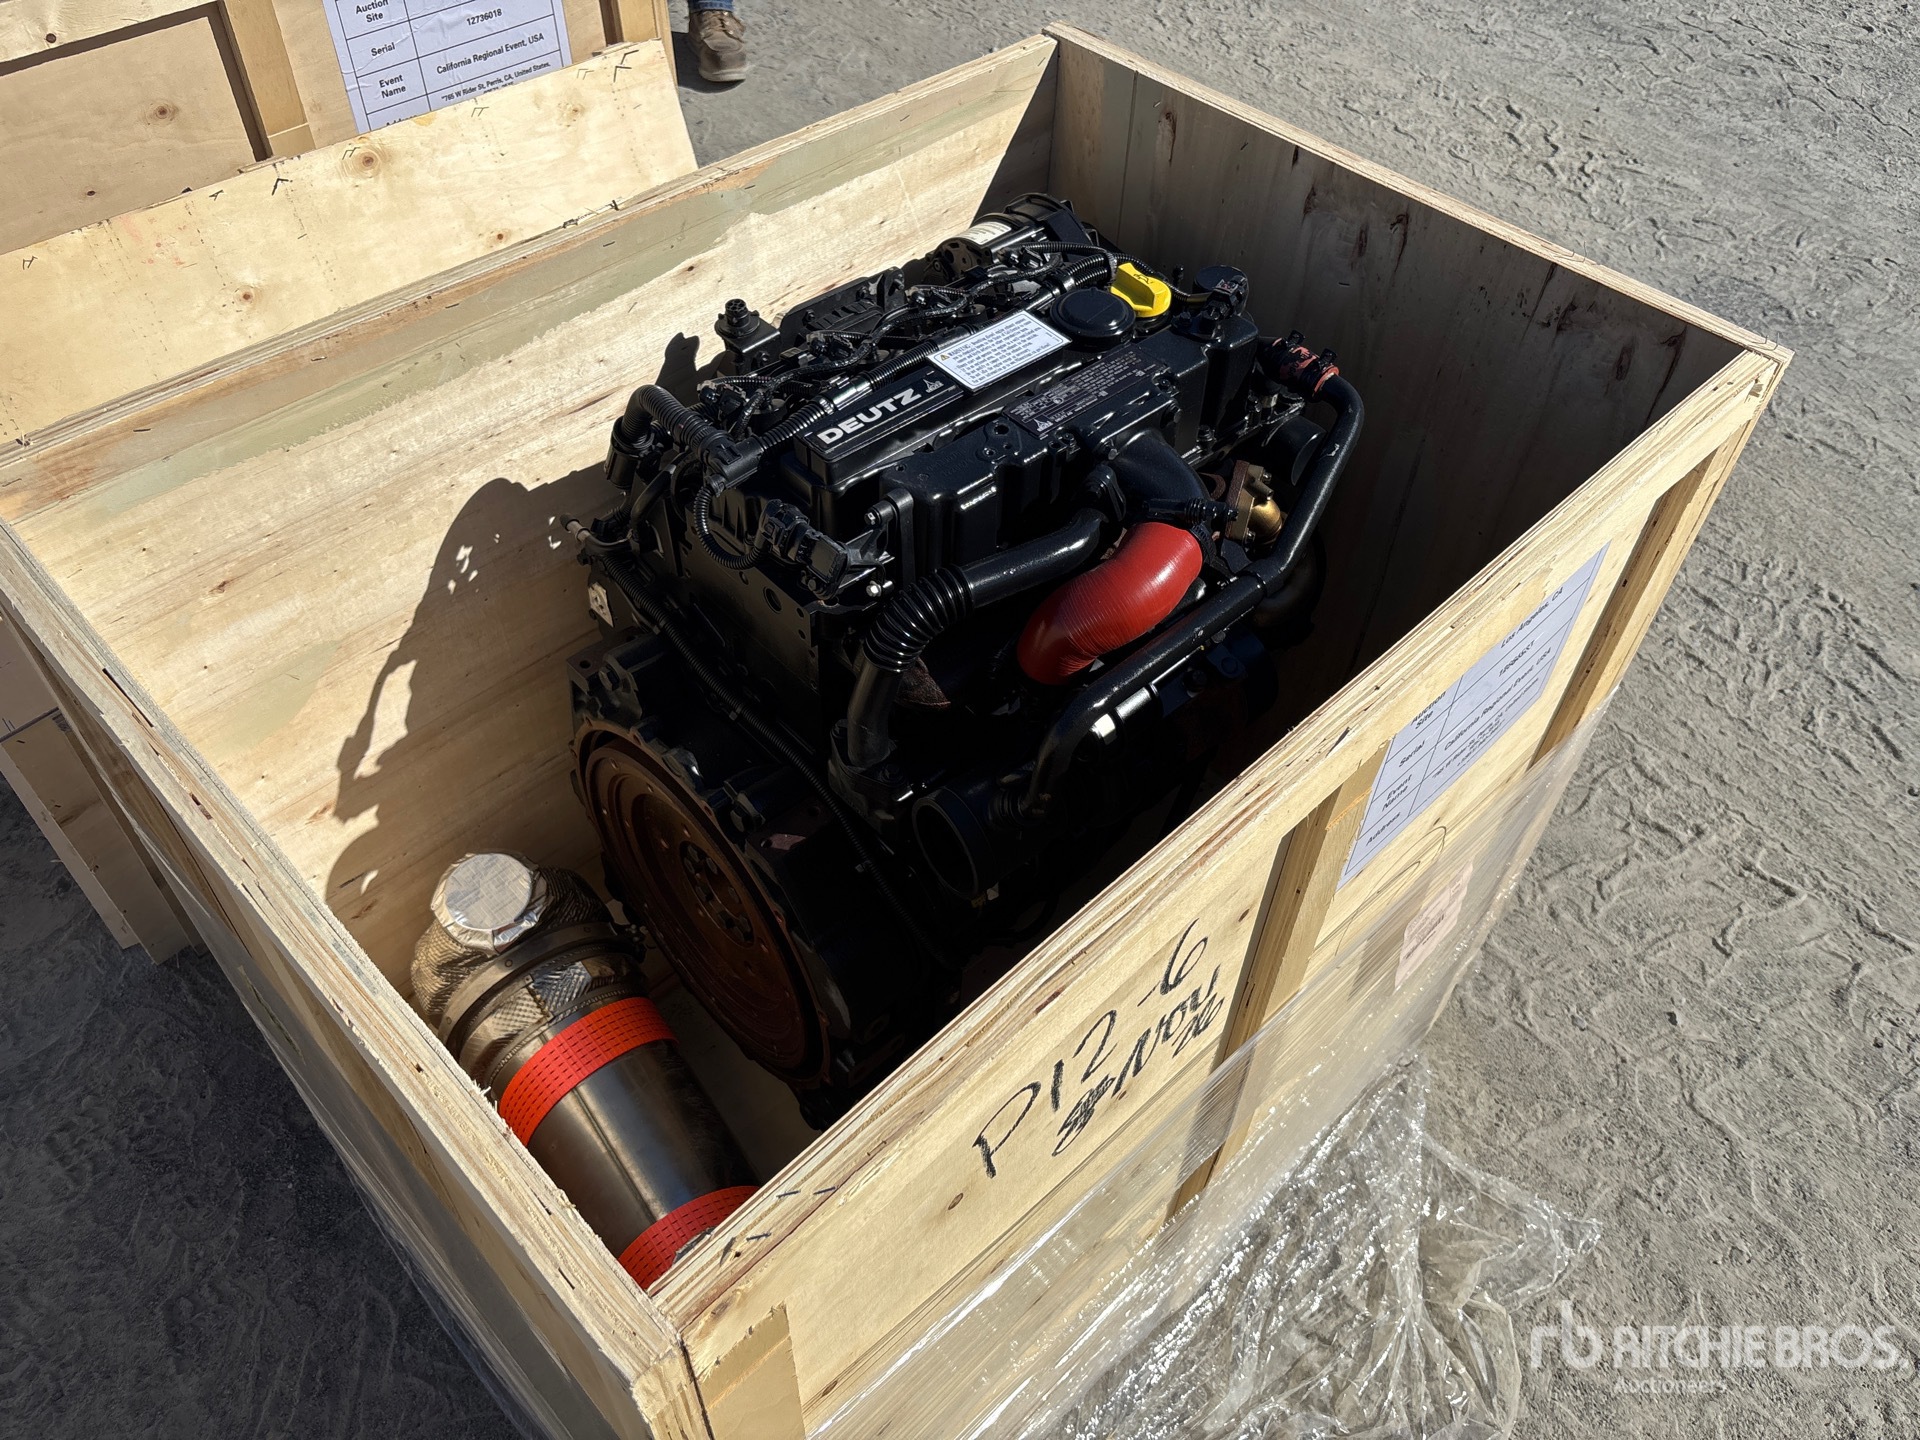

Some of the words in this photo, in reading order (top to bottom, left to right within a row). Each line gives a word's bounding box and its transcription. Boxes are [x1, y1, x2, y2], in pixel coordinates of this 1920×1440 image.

[356, 0, 389, 14] Auction
[366, 12, 384, 23] Site
[466, 8, 502, 26] 12736018
[371, 42, 395, 56] Serial
[436, 57, 472, 74] California
[473, 46, 504, 62] Regional
[505, 40, 527, 52] Event,
[528, 32, 545, 44] USA
[379, 74, 404, 88] Event
[462, 86, 477, 96] Rider
[514, 67, 532, 78] United
[381, 85, 406, 99] Name
[817, 387, 922, 445] DEUTZ
[1415, 710, 1433, 729] Site
[1398, 741, 1425, 767] Serial
[1386, 774, 1412, 800] Event
[1382, 785, 1408, 812] Name
